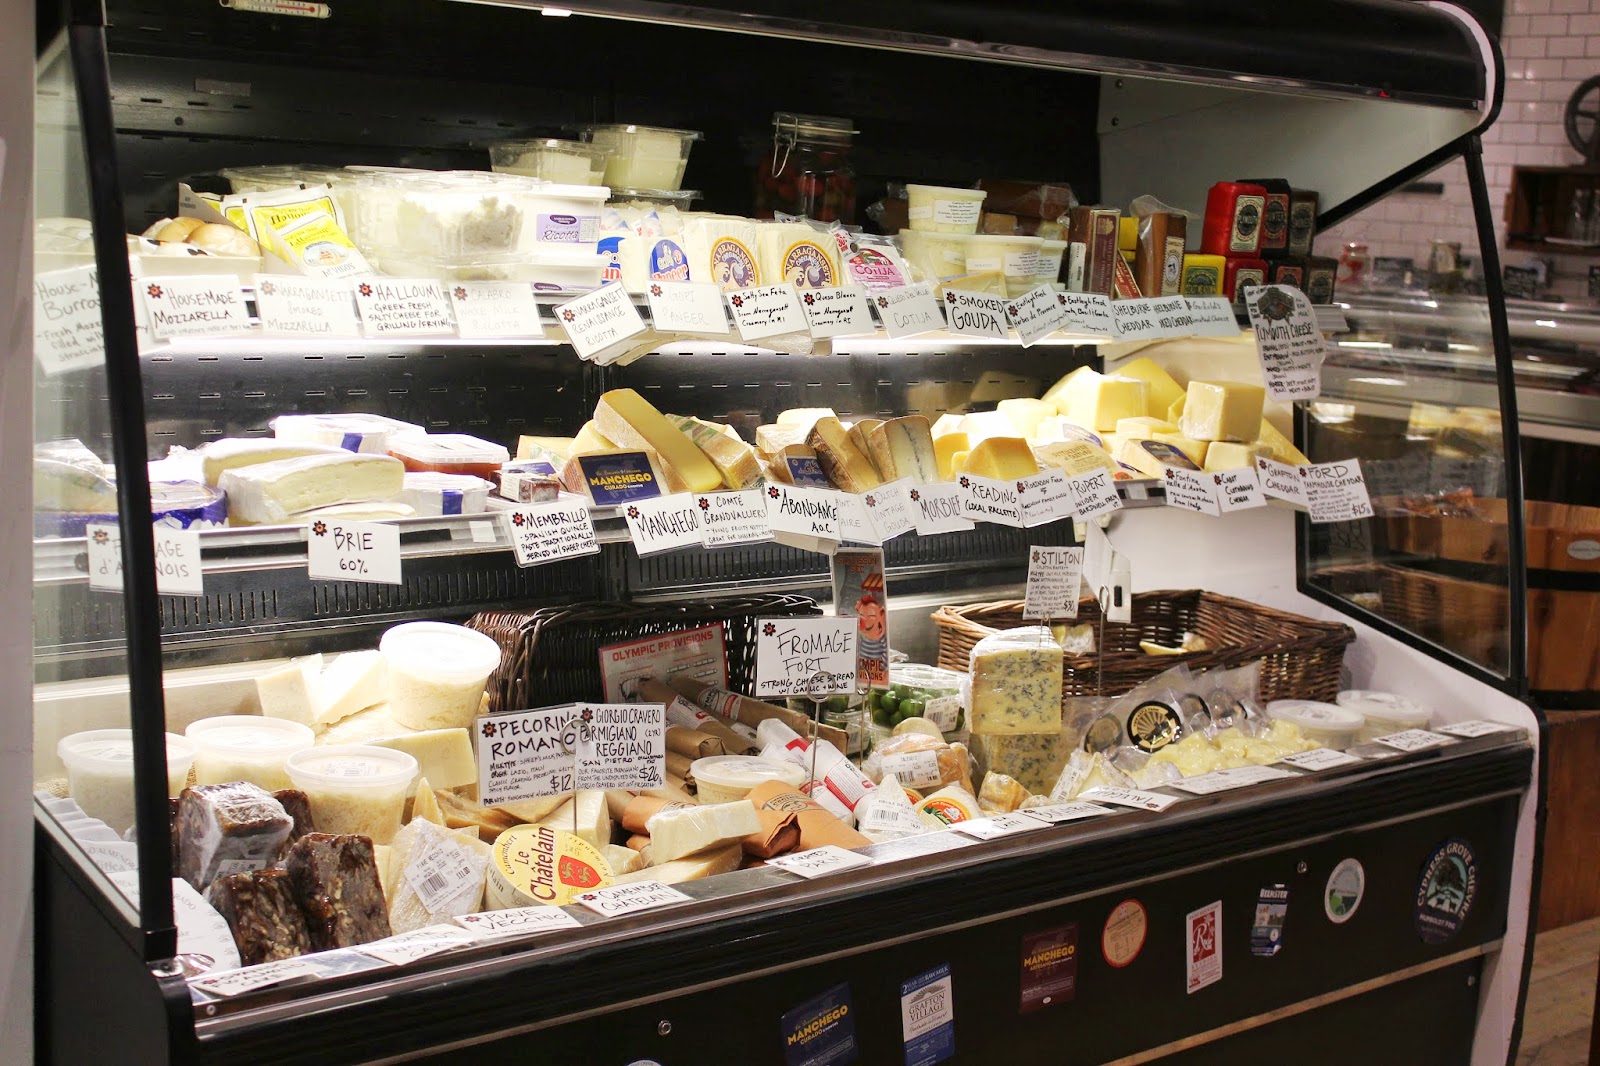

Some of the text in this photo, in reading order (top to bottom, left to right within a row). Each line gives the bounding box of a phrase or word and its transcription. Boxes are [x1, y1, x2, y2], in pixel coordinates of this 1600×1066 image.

[541, 229, 579, 241] Ricotta
[854, 265, 895, 276] COTIJA
[375, 284, 442, 302] HALLOUMI
[470, 288, 513, 301] CALABRO
[770, 287, 788, 298] Feta
[815, 292, 834, 302] Queso
[288, 301, 323, 316] SMOKED
[374, 301, 432, 313] GREEK FRESH
[573, 287, 627, 319] NARRAGANSETT
[959, 295, 1004, 314] SMOKED
[1113, 302, 1152, 317] SHELBURNE
[153, 310, 233, 329] MOZZARELLA
[267, 318, 332, 333] MOZZARELLA
[368, 310, 442, 323] SALTY CHEESE FOR
[472, 319, 521, 331] RICOTTA
[571, 304, 627, 335] RENAISSANCE
[660, 306, 709, 327] PANEER
[893, 311, 932, 329] COTIJA
[951, 306, 1003, 336] GOUDA
[1114, 317, 1155, 335] CHEDDAR
[1255, 323, 1291, 342] PLYMOUTH
[584, 327, 618, 347] RICOTTA
[590, 472, 652, 487] MANCHEGO
[1175, 470, 1200, 486] Fontina
[1267, 463, 1300, 483] GRAFTON
[1307, 465, 1349, 480] FORD
[1335, 475, 1364, 488] CHEDDAR
[604, 483, 628, 491] CURADO
[971, 482, 1017, 504] READING
[1072, 473, 1105, 498] RUPERT
[1265, 478, 1301, 495] CHEDDAR
[780, 488, 838, 521] ABONDANCE
[874, 487, 899, 505] DUTCH
[704, 509, 767, 525] GRANDVALLIERS
[873, 502, 905, 522] VINTAGE
[920, 494, 961, 522] MORBIE
[525, 507, 588, 531] MEMBRILLO
[636, 508, 700, 542] MANCHEGO
[883, 517, 911, 533] GOUDA
[560, 522, 590, 535] QUINCE
[333, 526, 375, 552] BRIE
[525, 549, 552, 562] SERVED
[1041, 551, 1080, 565] STILTON
[338, 557, 369, 574] 60%
[612, 643, 656, 662] OLYMPIC
[658, 630, 714, 651] PROVISIONS
[776, 627, 853, 656] FROMAGE
[782, 656, 830, 677] FORT
[760, 677, 793, 689] STRONG
[595, 708, 661, 725] GIORGIO CRAVERO
[491, 732, 577, 760] ROMANO
[596, 740, 652, 757] REGGIANO
[550, 773, 572, 793] $12
[503, 834, 518, 875] Camembert
[514, 850, 530, 865] Le
[529, 826, 557, 901] Châtelain
[1416, 848, 1447, 908] CYPRESS
[1446, 842, 1474, 866] GROVE
[480, 912, 568, 930] VECCHIO
[484, 908, 537, 923] PIAVE
[1023, 944, 1075, 968] MANCHEGO
[908, 992, 946, 1015] GRAFTON
[910, 1000, 946, 1022] VILLAGE
[787, 1004, 849, 1046] MANCHEGO
